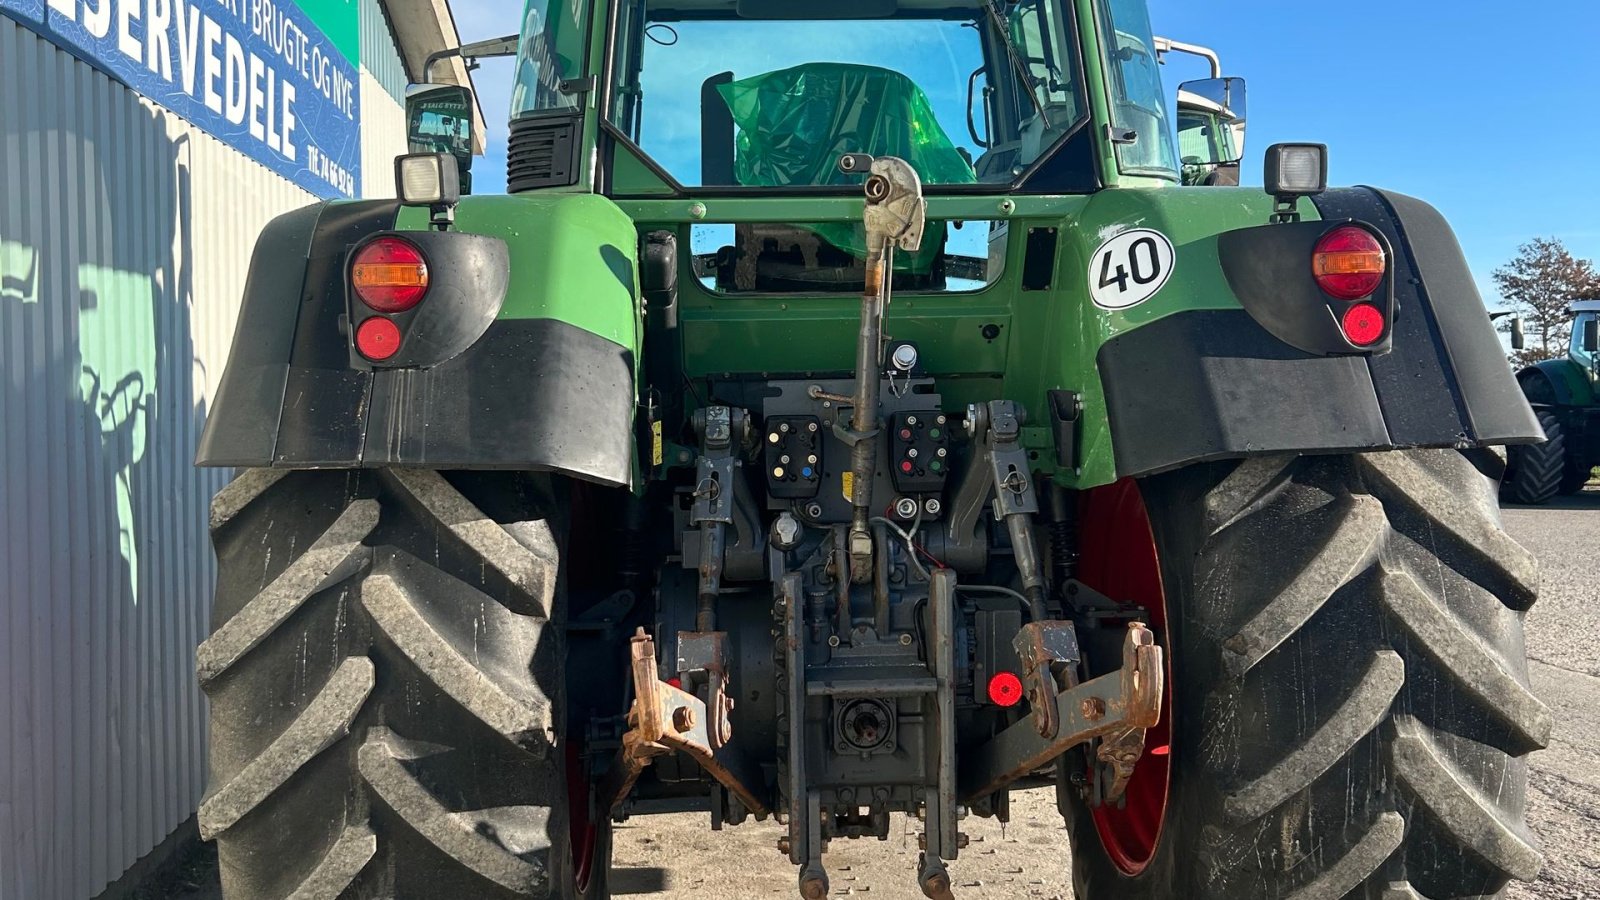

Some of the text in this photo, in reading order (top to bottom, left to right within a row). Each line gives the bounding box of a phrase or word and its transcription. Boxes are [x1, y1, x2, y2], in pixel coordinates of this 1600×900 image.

[252, 0, 309, 79] BRUGTE
[312, 46, 330, 99] OG
[333, 65, 353, 120] NYE
[320, 153, 329, 182] 74
[330, 160, 338, 188] 66
[338, 166, 347, 194] 92
[1099, 237, 1161, 293] 40
